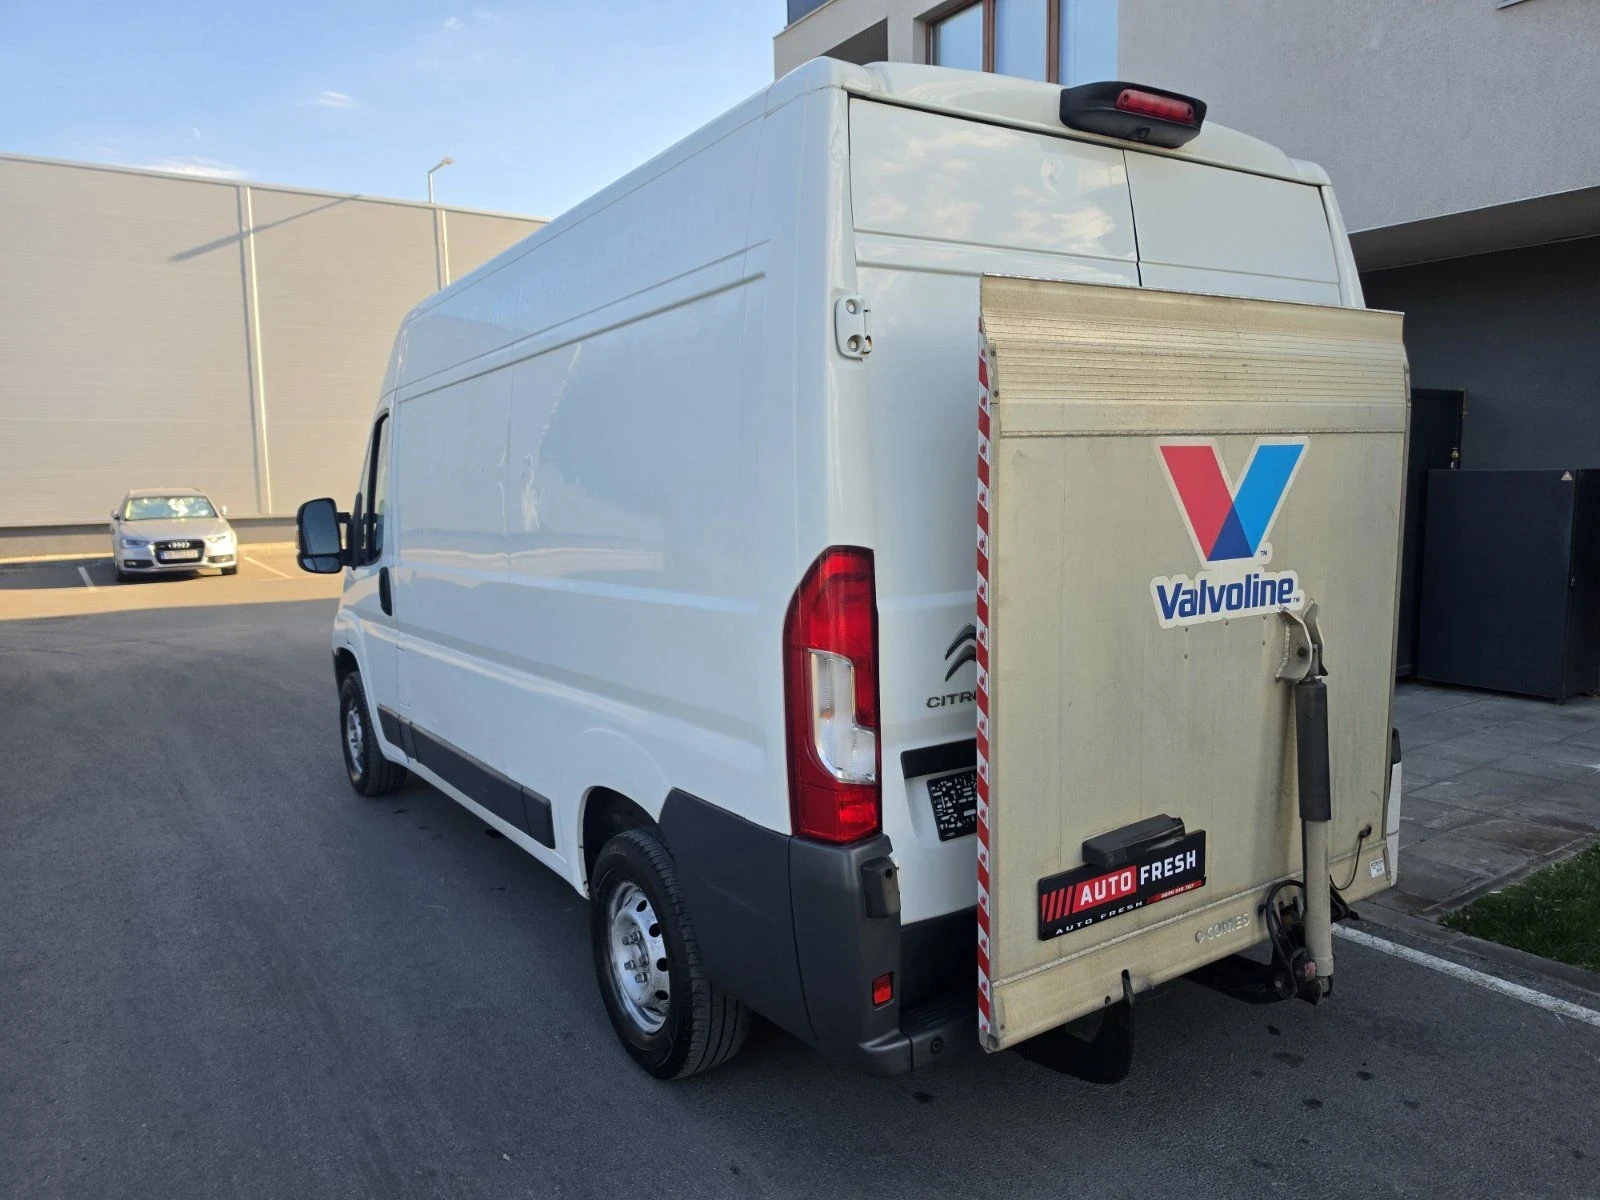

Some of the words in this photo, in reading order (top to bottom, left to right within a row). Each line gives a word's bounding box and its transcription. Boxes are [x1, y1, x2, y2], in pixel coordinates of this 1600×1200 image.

[1156, 573, 1294, 620] Valvoline
[1080, 871, 1132, 905] AUTO
[1140, 850, 1196, 885] FRESH
[1055, 918, 1093, 935] AUTO
[1100, 901, 1143, 920] FRESH
